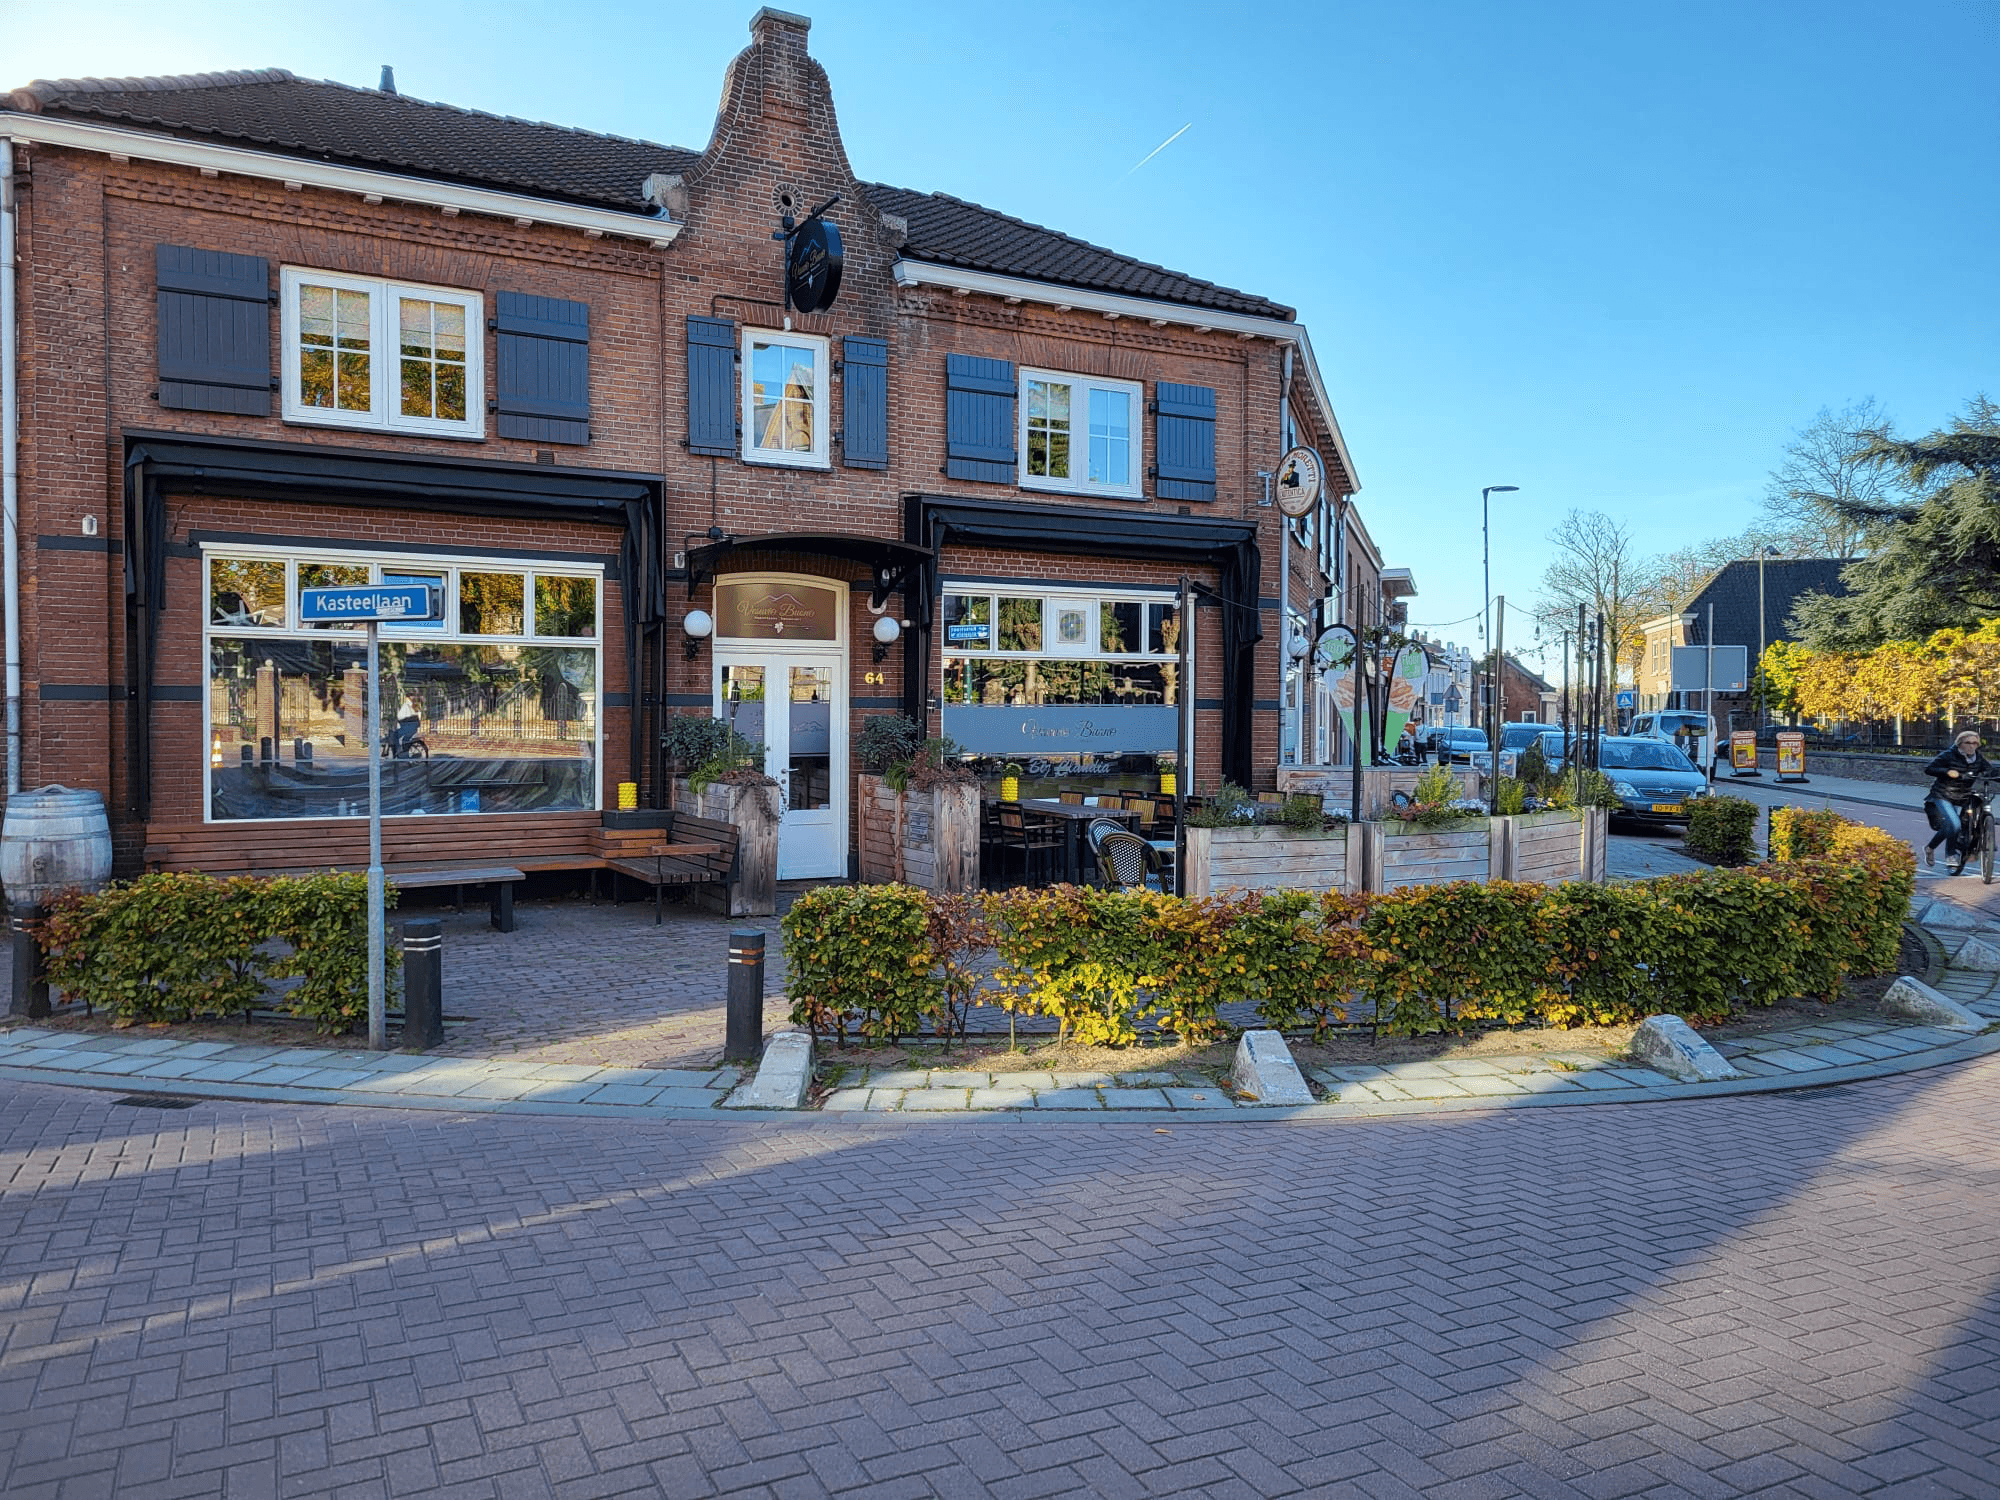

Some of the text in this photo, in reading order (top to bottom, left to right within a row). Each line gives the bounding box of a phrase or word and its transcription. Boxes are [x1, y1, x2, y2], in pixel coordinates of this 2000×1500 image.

[1293, 451, 1317, 483] MORETTI
[316, 593, 413, 612] Kasteellaan
[864, 672, 885, 685] 64
